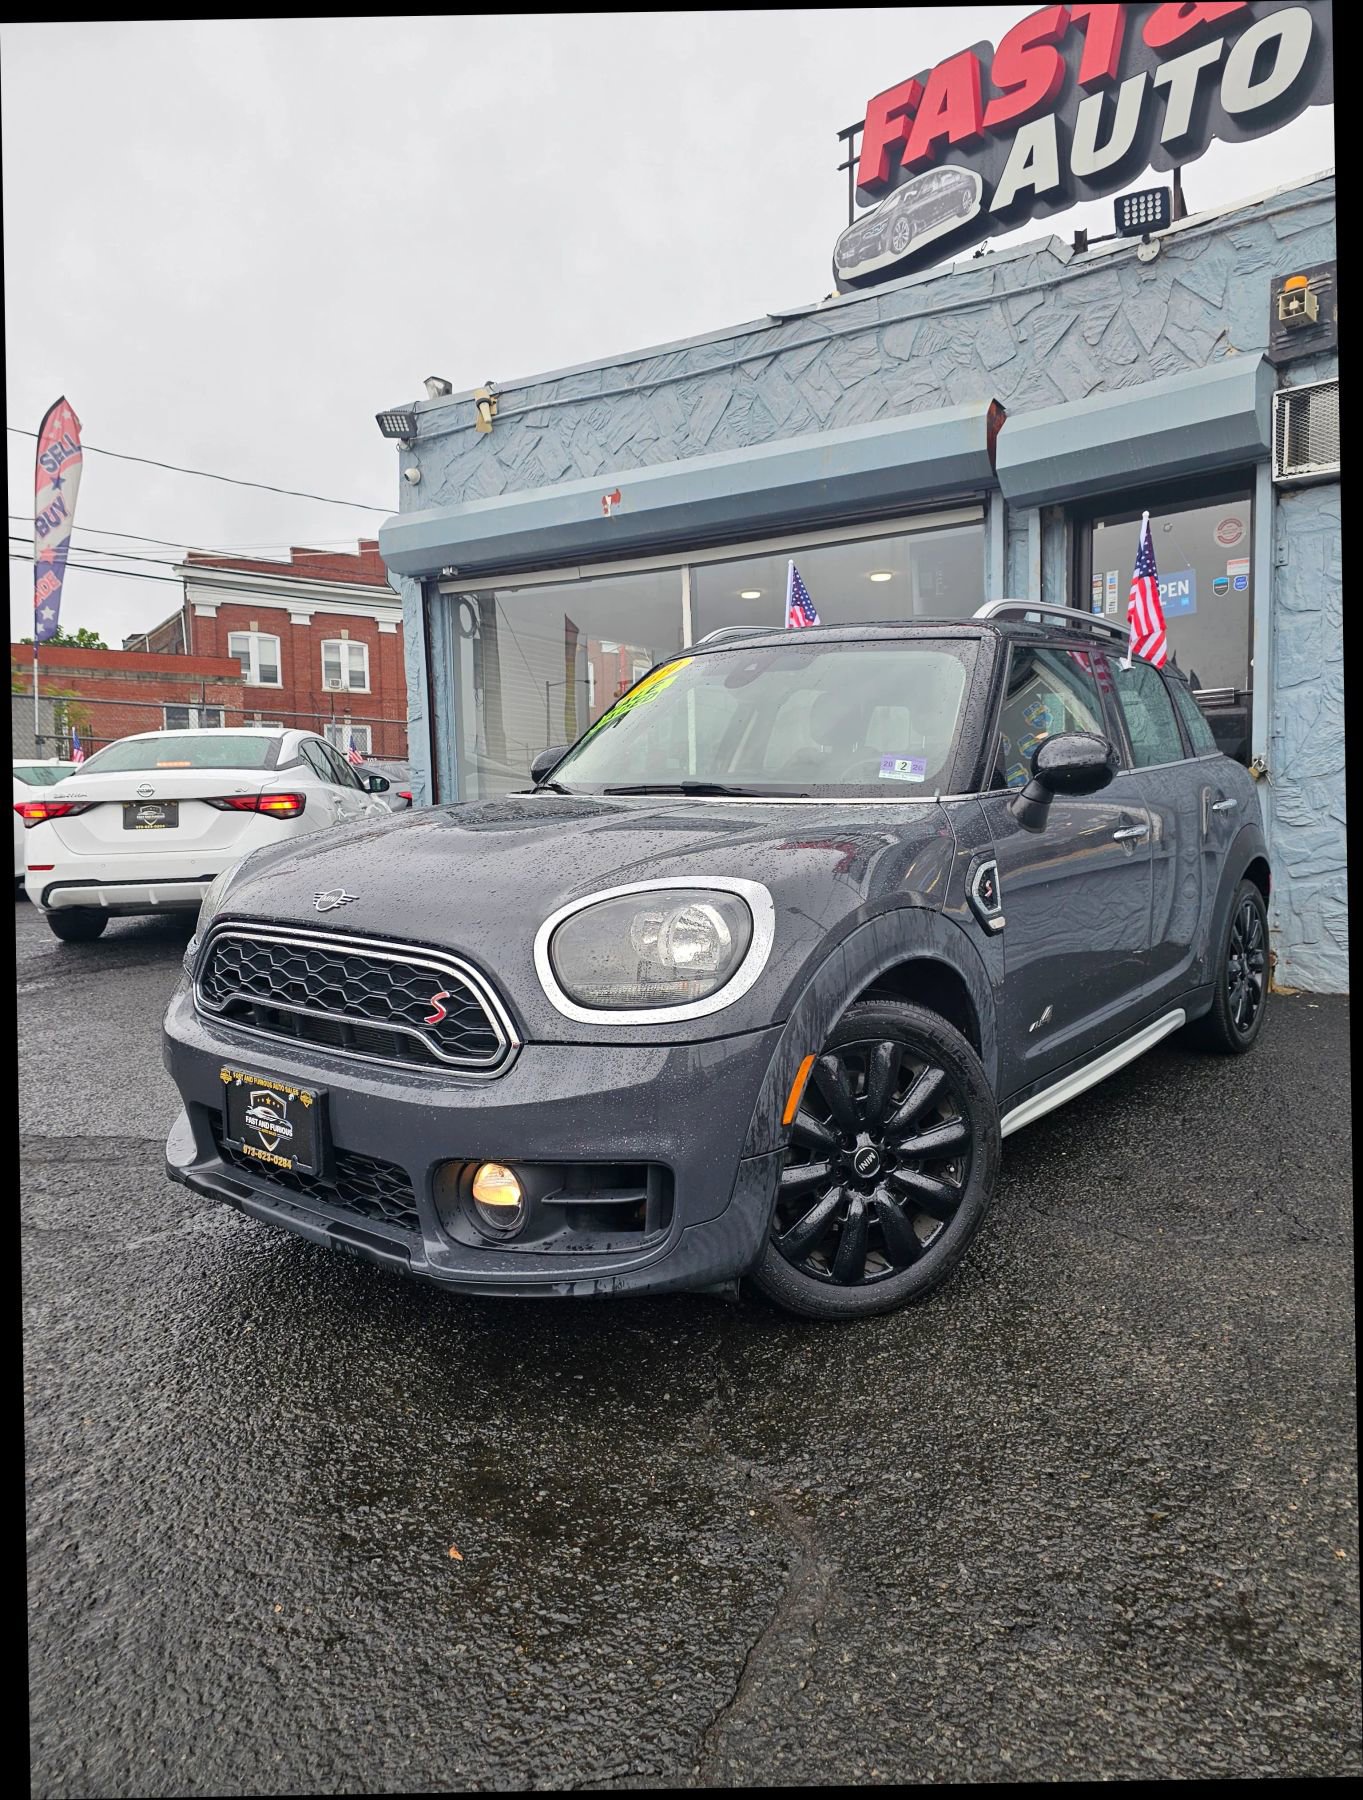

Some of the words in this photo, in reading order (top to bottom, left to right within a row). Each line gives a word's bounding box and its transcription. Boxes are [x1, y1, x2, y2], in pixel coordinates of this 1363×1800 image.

[857, 3, 1126, 190] FAST
[988, 6, 1313, 213] AUTO
[39, 432, 82, 475] SELL
[34, 496, 69, 538] BUY
[1158, 579, 1189, 598] PEN
[900, 762, 907, 770] 2
[424, 991, 450, 1025] S
[244, 1075, 254, 1083] AND
[245, 1116, 258, 1125] FAST
[258, 1120, 269, 1129] AND
[269, 1123, 293, 1137] FURIOUS
[858, 1152, 876, 1171] MINI
